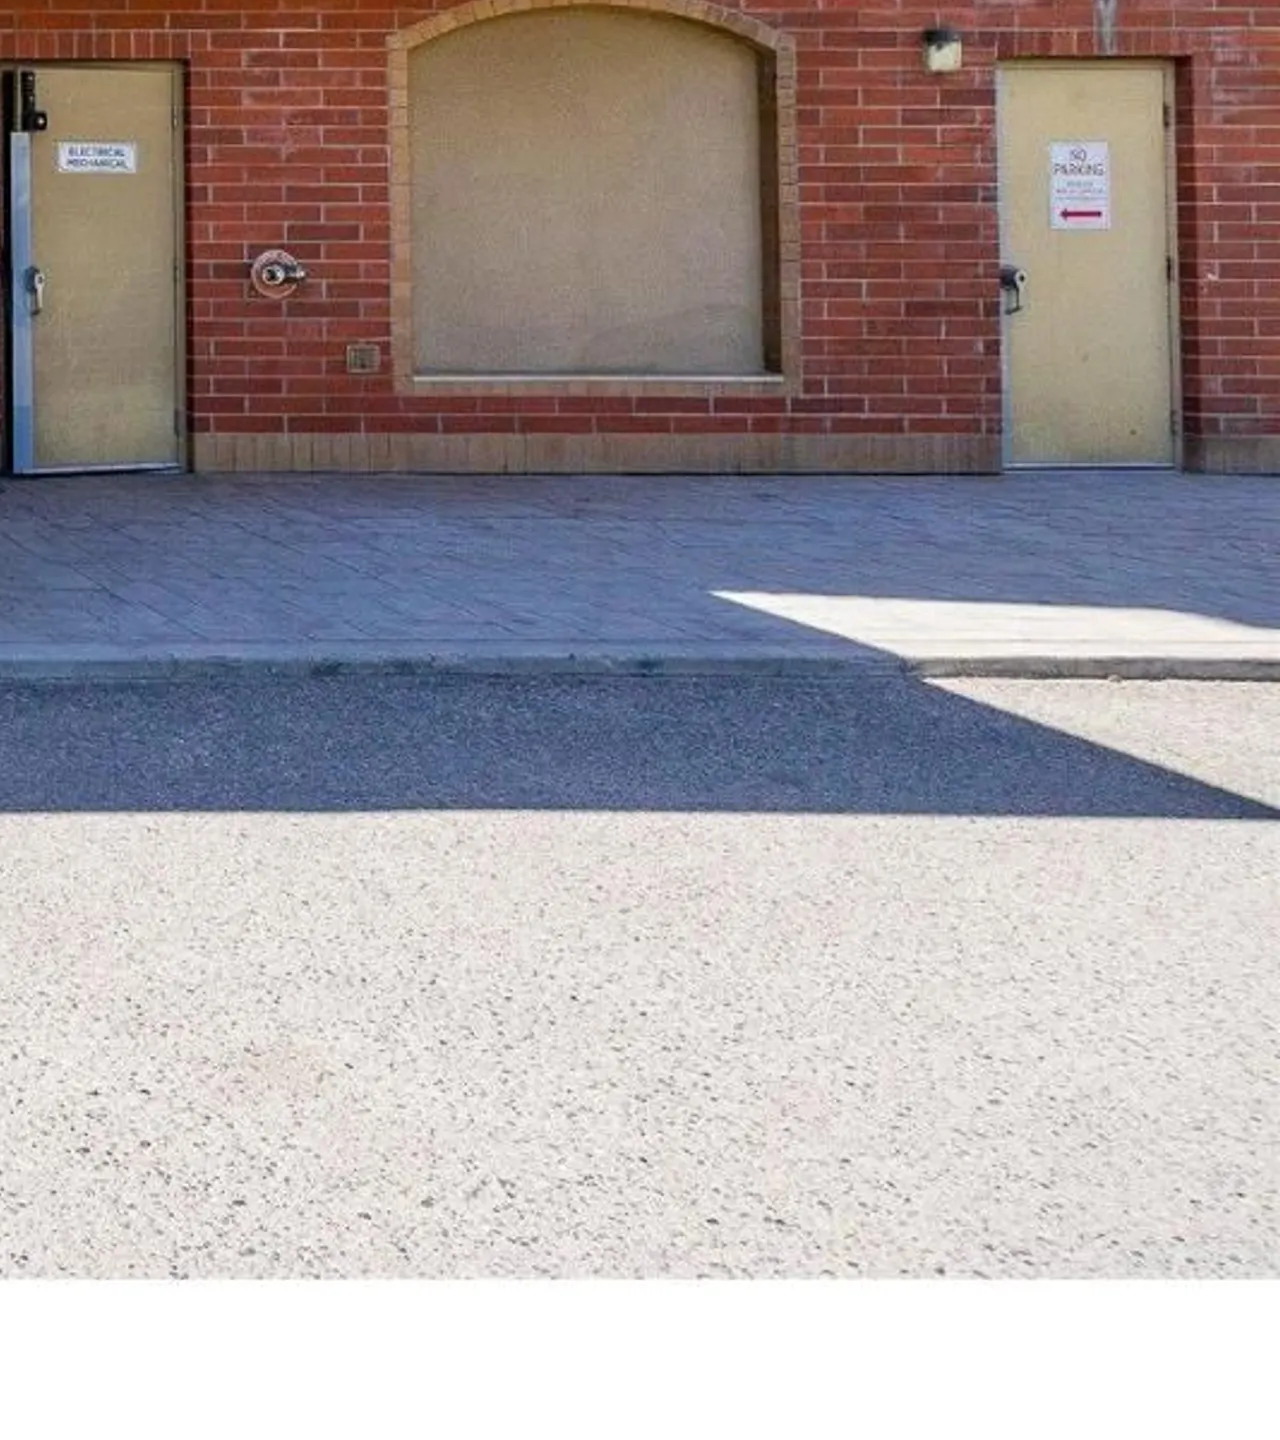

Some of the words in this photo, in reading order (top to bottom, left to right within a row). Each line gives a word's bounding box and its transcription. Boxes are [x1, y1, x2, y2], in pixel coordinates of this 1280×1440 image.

[68, 146, 126, 157] ELECTRICAL
[1069, 148, 1088, 162] NO
[67, 159, 129, 169] MECHANICAL
[1052, 163, 1105, 176] PARKING
